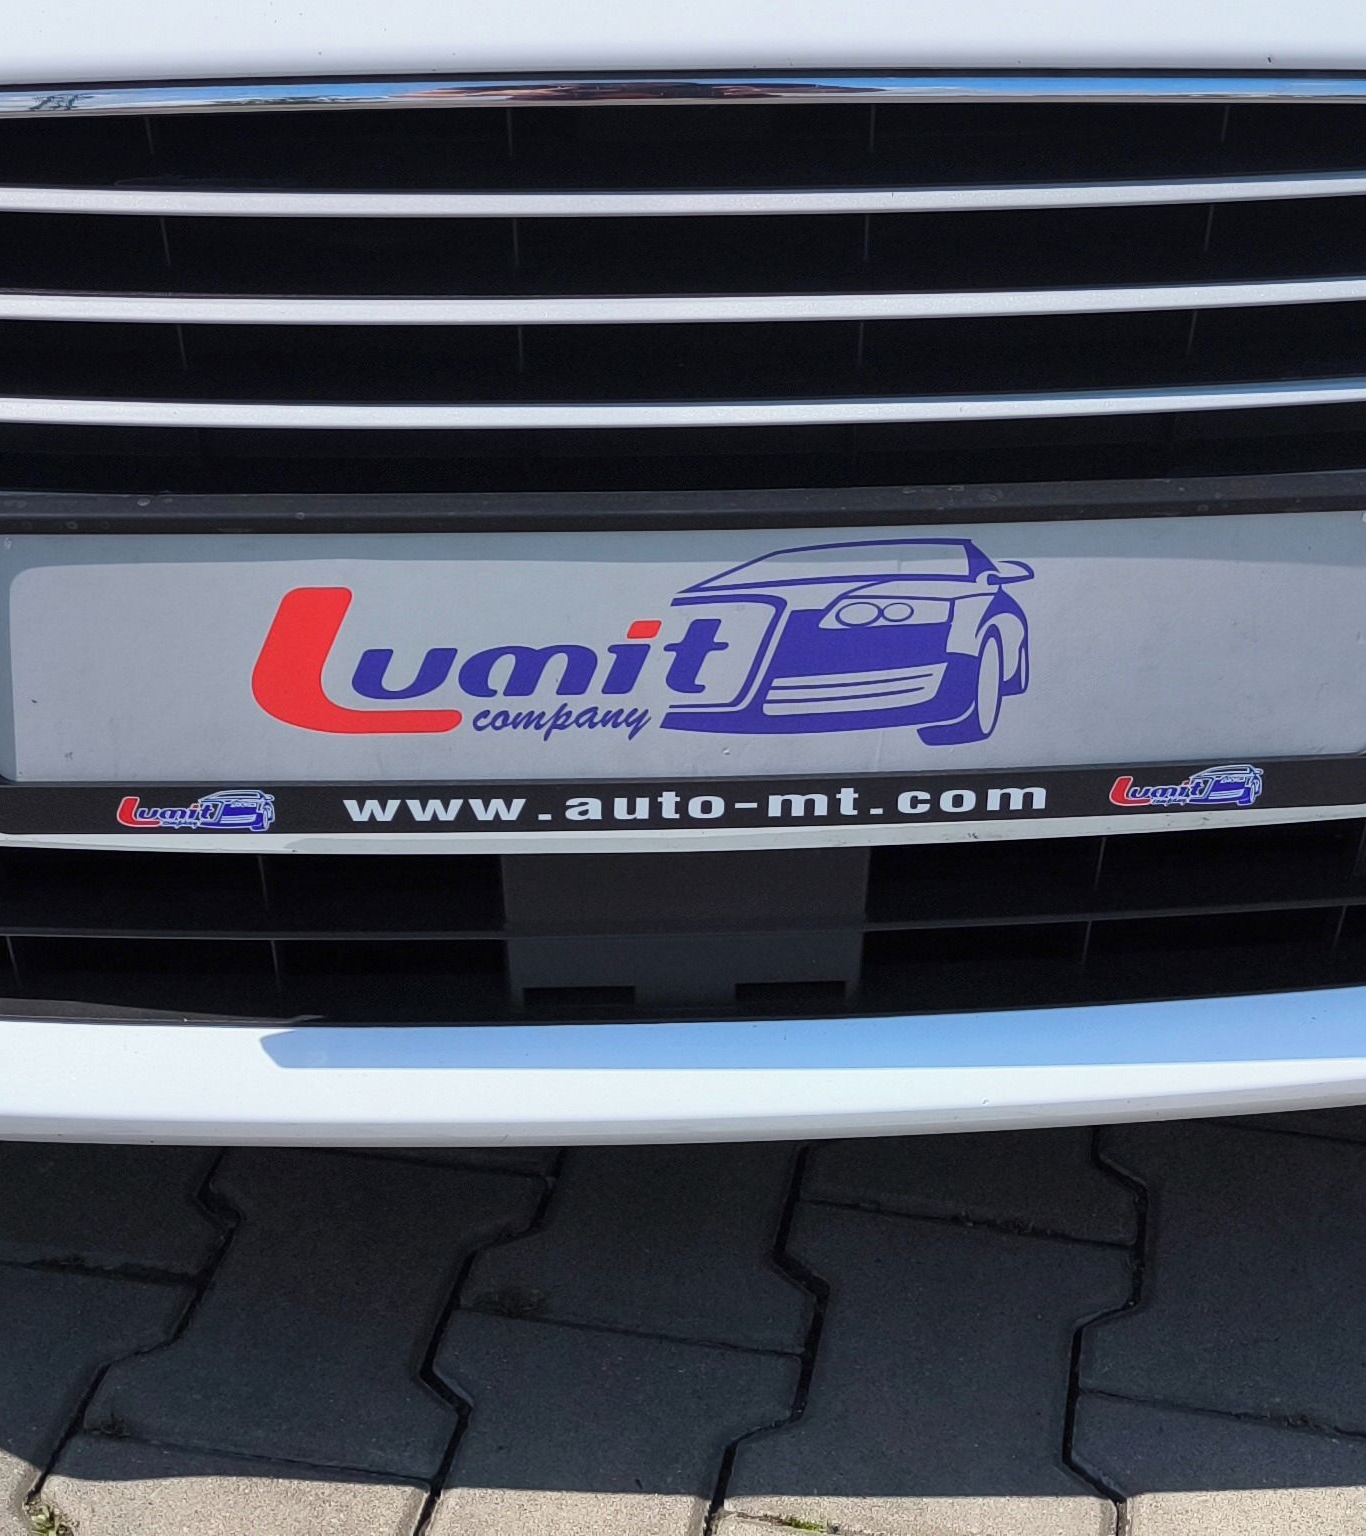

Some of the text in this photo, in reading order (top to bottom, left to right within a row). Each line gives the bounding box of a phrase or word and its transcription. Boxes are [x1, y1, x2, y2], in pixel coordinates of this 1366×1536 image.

[251, 586, 729, 734] Lumit
[472, 702, 652, 742] company
[342, 786, 1048, 822] www.auto-mt.com
[1110, 776, 1204, 806] Lumit
[117, 797, 214, 827] Lumit
